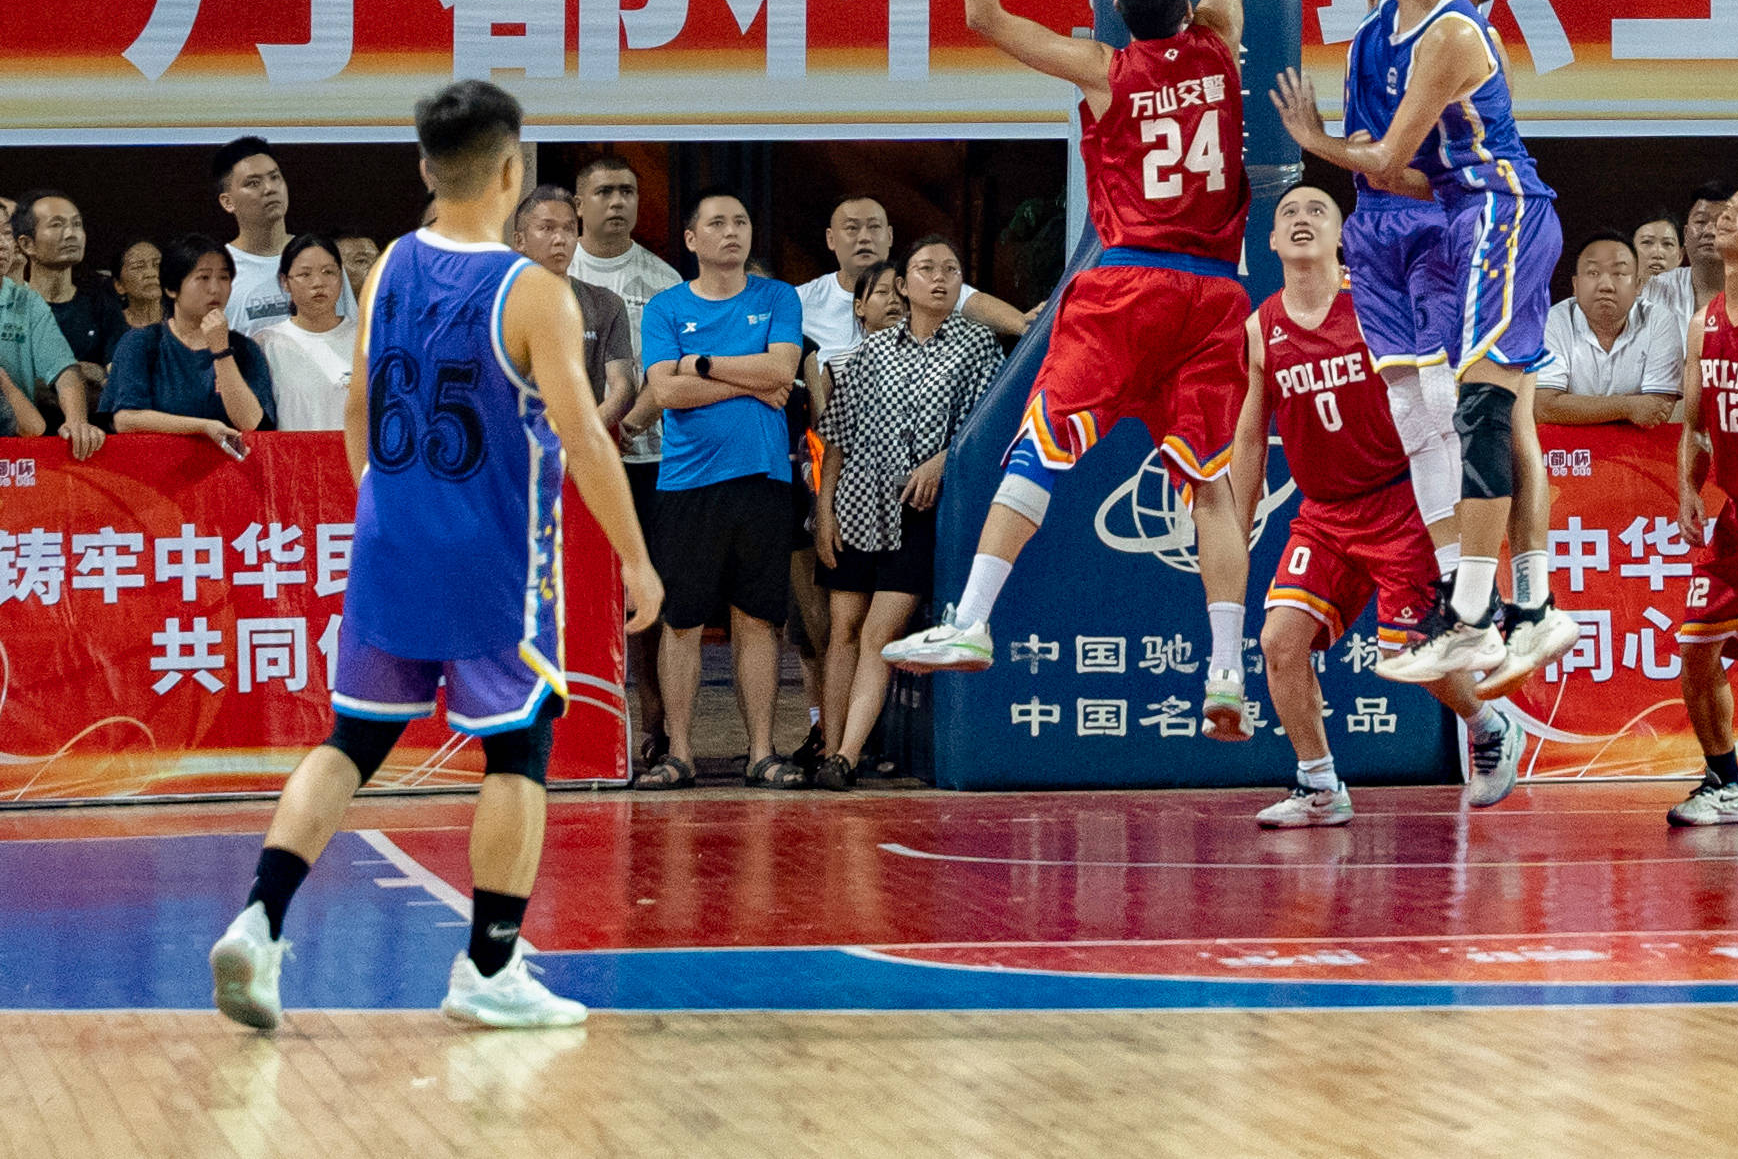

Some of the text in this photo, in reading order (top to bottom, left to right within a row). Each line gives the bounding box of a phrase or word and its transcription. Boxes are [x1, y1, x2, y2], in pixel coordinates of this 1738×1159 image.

[1129, 73, 1226, 118] 万山交警
[1139, 109, 1227, 200] 24
[1275, 352, 1366, 398] POLICE
[369, 346, 488, 483] 65
[1314, 391, 1343, 432] 0
[1287, 546, 1311, 575] 0
[1686, 577, 1711, 607] 12
[150, 613, 343, 696] 共同
[1010, 633, 1384, 675] 中国驰标
[1010, 695, 1399, 738] 中国名品
